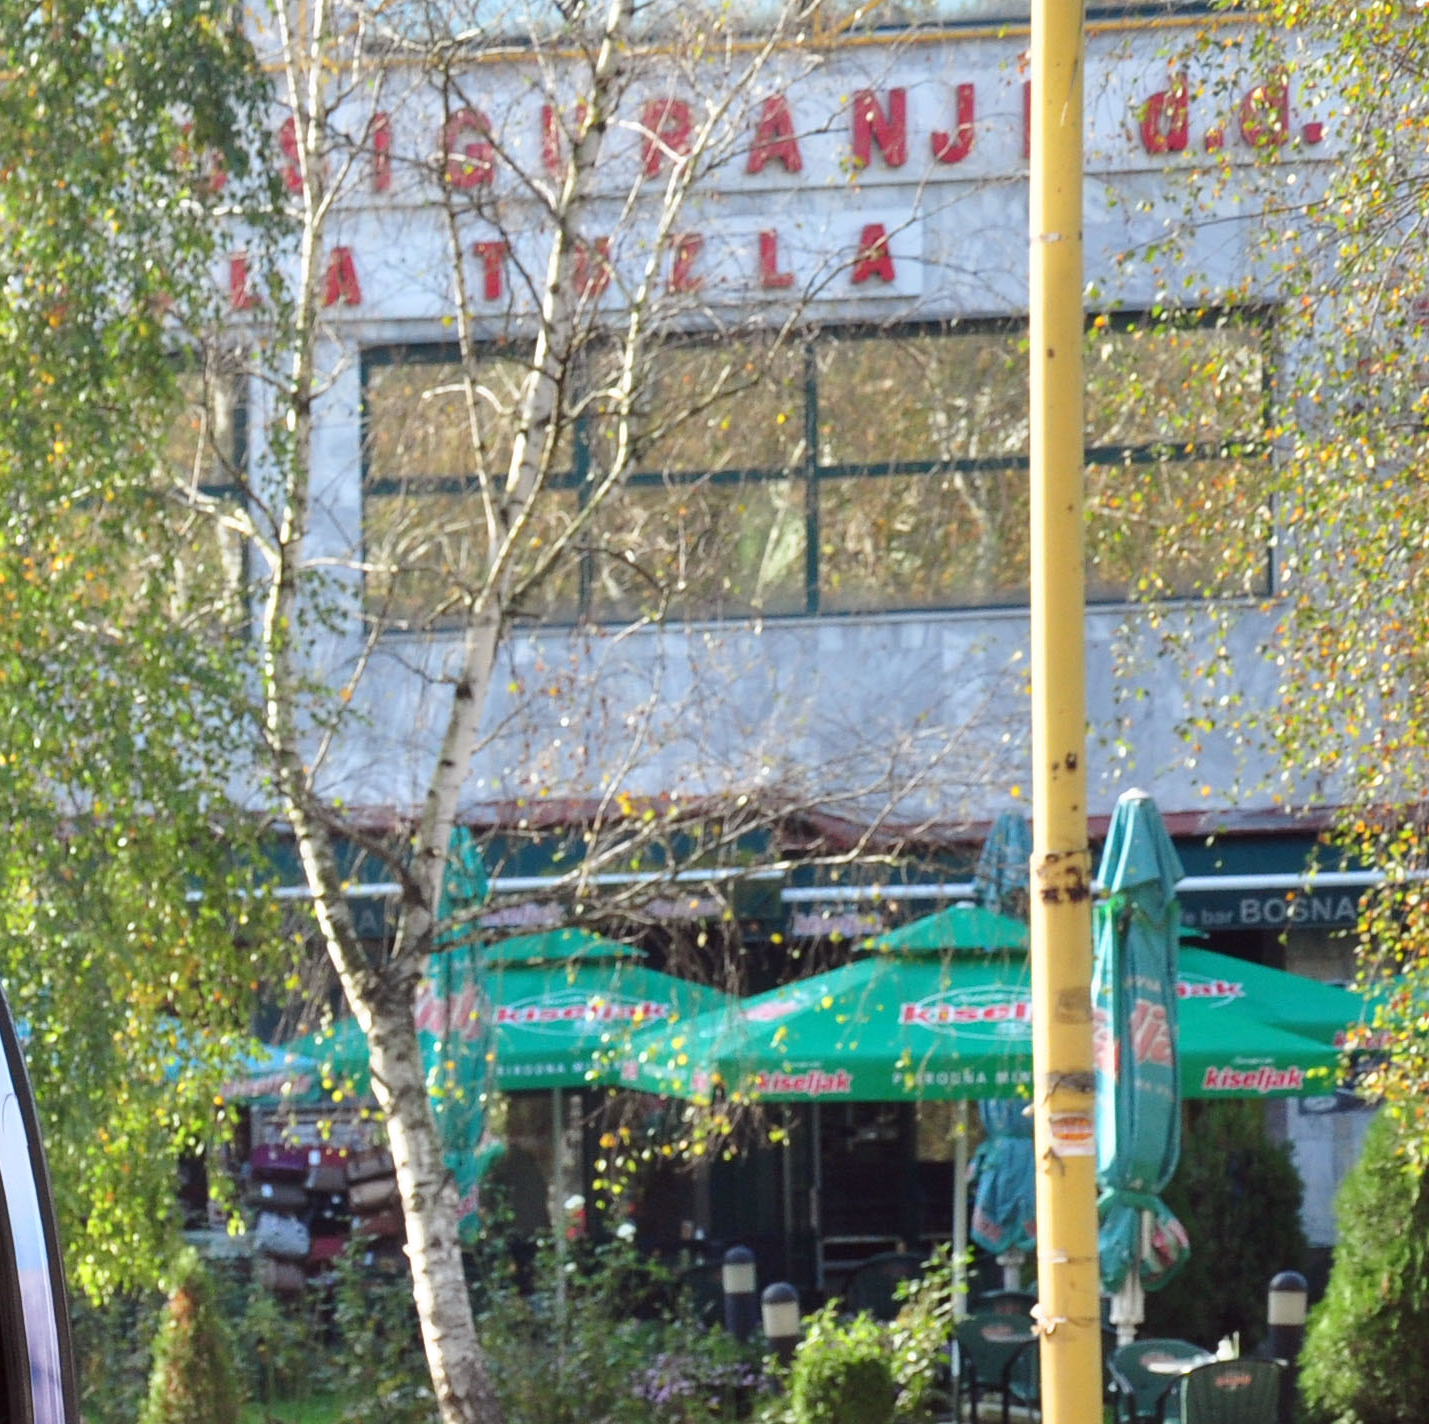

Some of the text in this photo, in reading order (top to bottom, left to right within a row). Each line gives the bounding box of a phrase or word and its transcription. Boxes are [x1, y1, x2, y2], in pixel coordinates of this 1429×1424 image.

[1240, 897, 1356, 923] BOSNA
[756, 1070, 853, 1096] kiseljak
[1201, 1065, 1306, 1095] kiseljak
